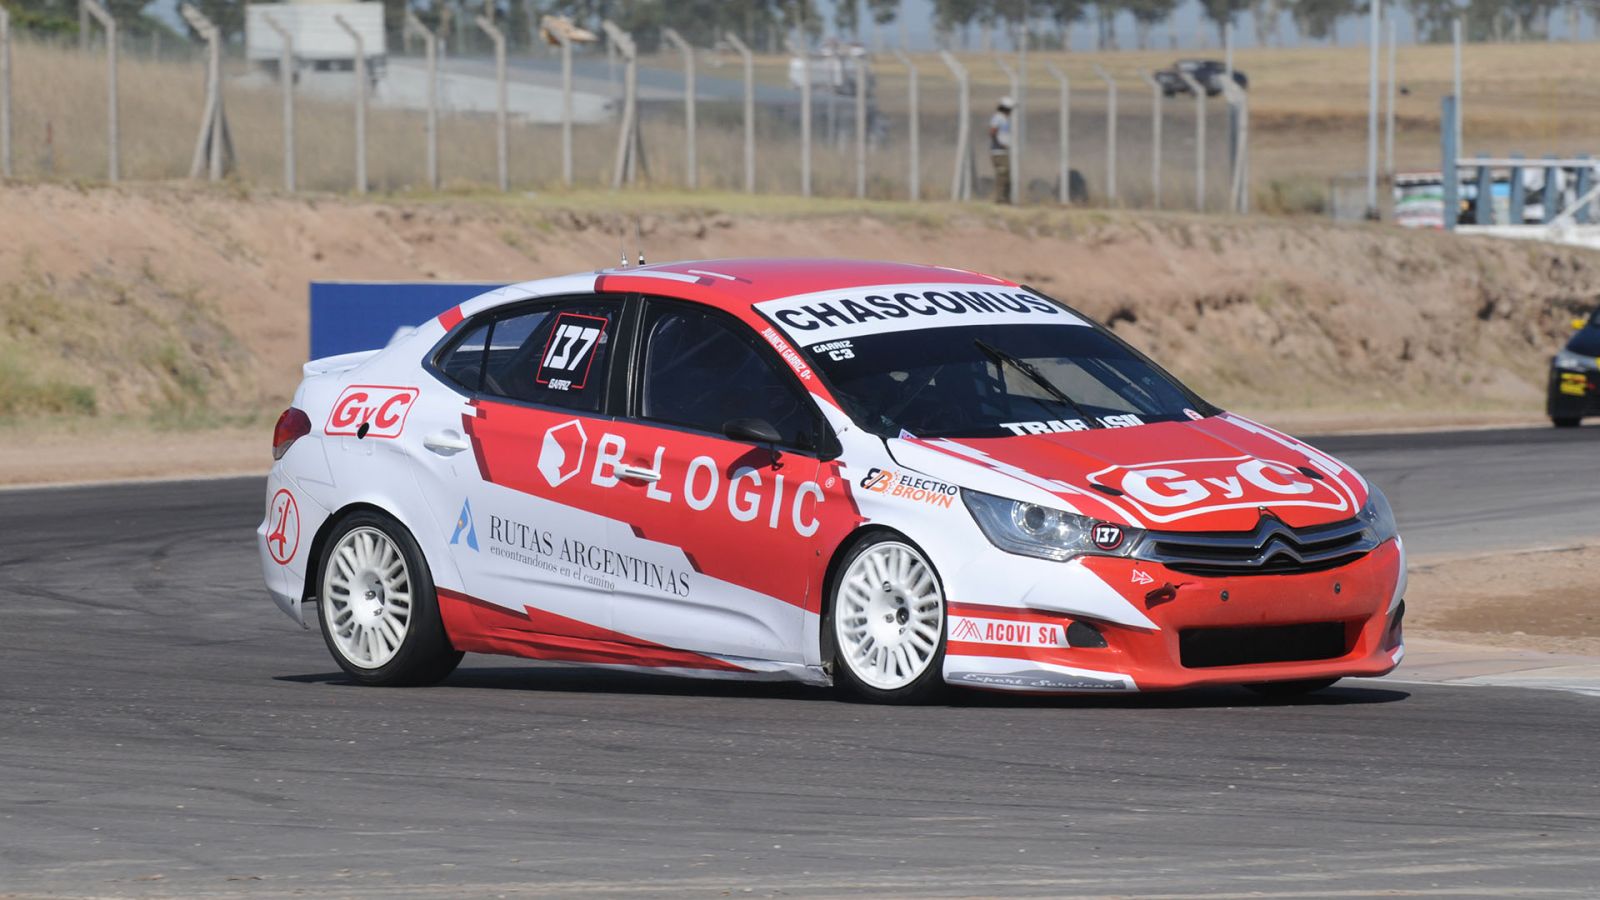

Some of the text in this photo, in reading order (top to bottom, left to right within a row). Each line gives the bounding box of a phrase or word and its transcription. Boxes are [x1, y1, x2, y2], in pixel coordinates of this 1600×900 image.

[774, 291, 1059, 331] CHASCOMUS
[543, 324, 600, 371] 137
[761, 327, 788, 353] JUANCHI
[782, 348, 806, 373] GARRIZ
[812, 340, 853, 354] GARRIZ
[828, 348, 855, 361] C3
[332, 392, 411, 429] GyC
[891, 484, 954, 509] BROWN
[900, 475, 958, 496] ELECTRO
[1121, 459, 1314, 507] GyC
[1095, 526, 1120, 543] 137
[490, 514, 690, 597] RUTAS ARGENTINAS
[490, 545, 615, 591] encontrandonos en el camino
[985, 623, 1058, 645] ACOVI SA
